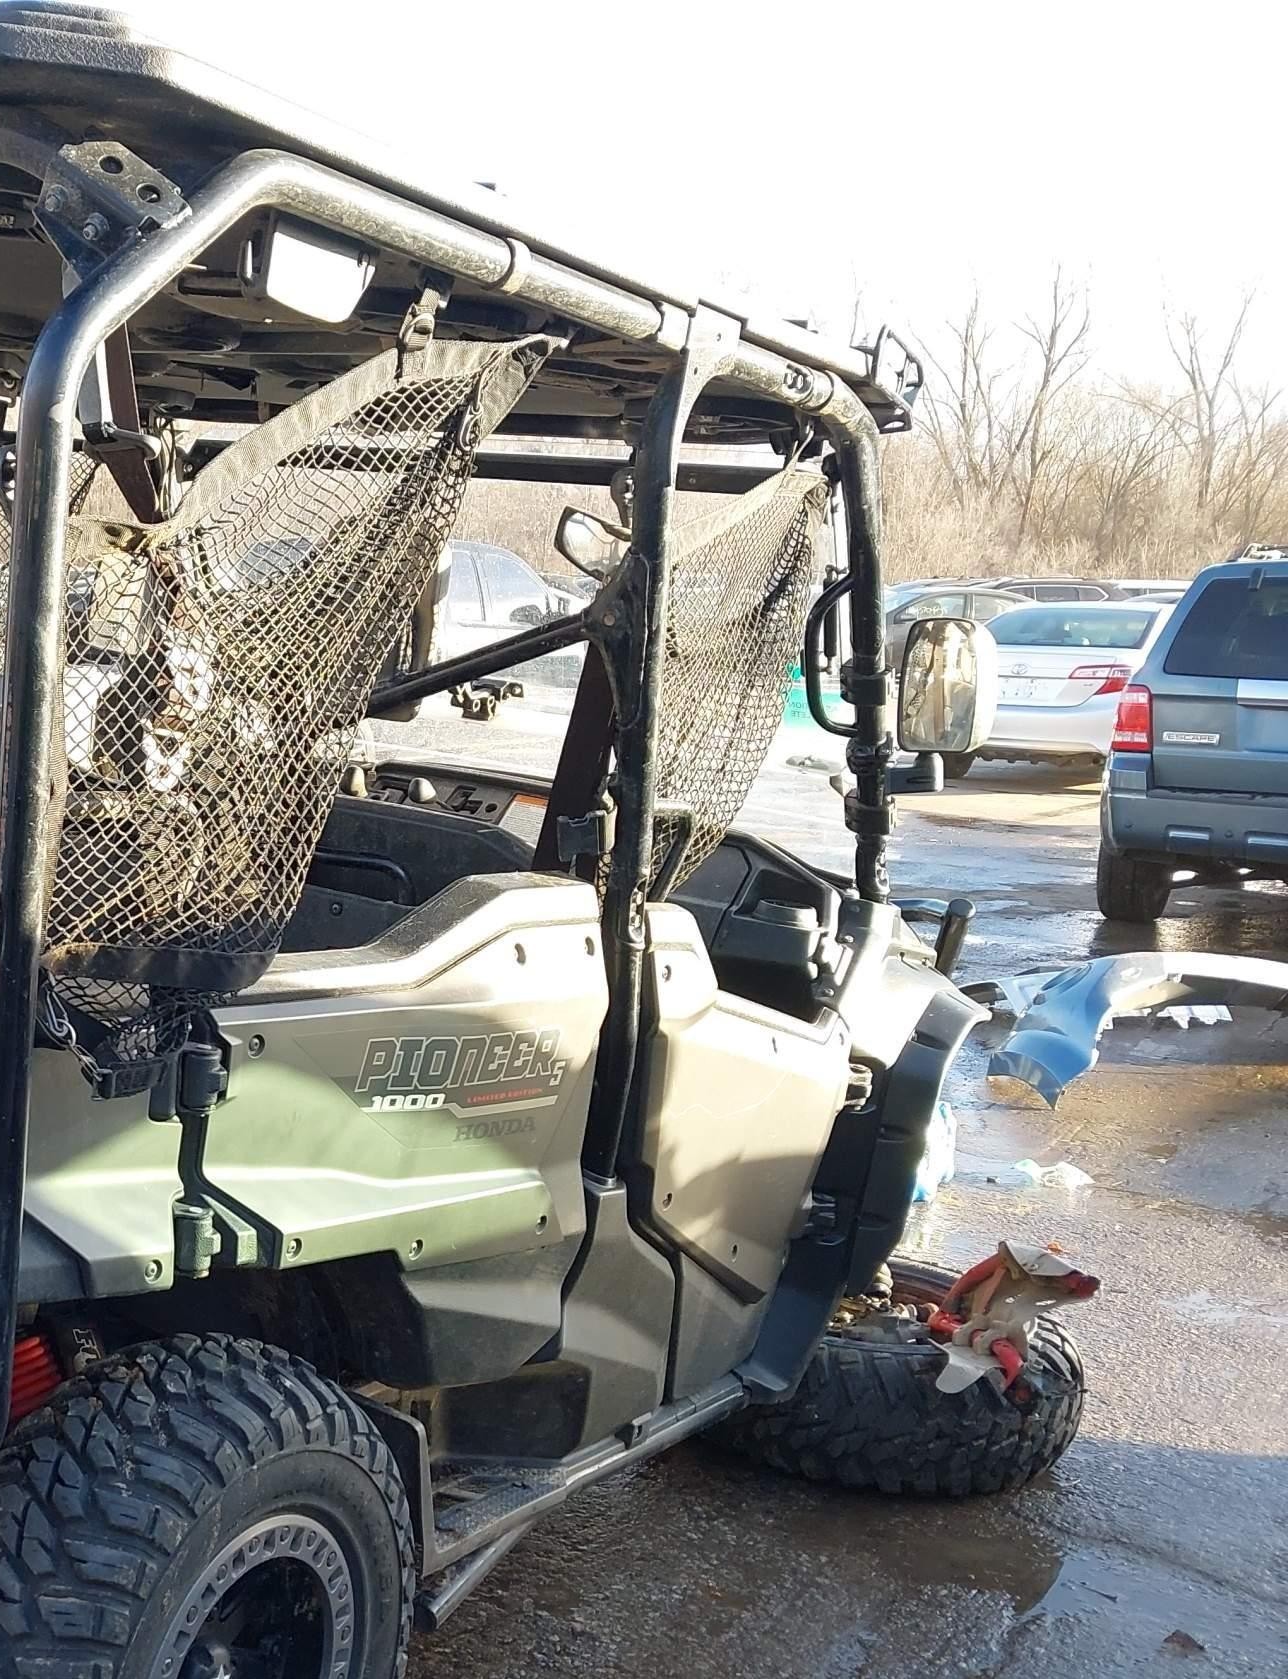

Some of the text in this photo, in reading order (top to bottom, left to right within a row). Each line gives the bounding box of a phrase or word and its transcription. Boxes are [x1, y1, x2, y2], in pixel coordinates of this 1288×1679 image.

[1164, 732, 1217, 743] ESCAPE
[355, 1028, 560, 1092] PIONEER
[370, 1094, 446, 1111] 1000
[467, 1088, 542, 1103] LIMITED EDITION
[453, 1117, 536, 1142] HONDA
